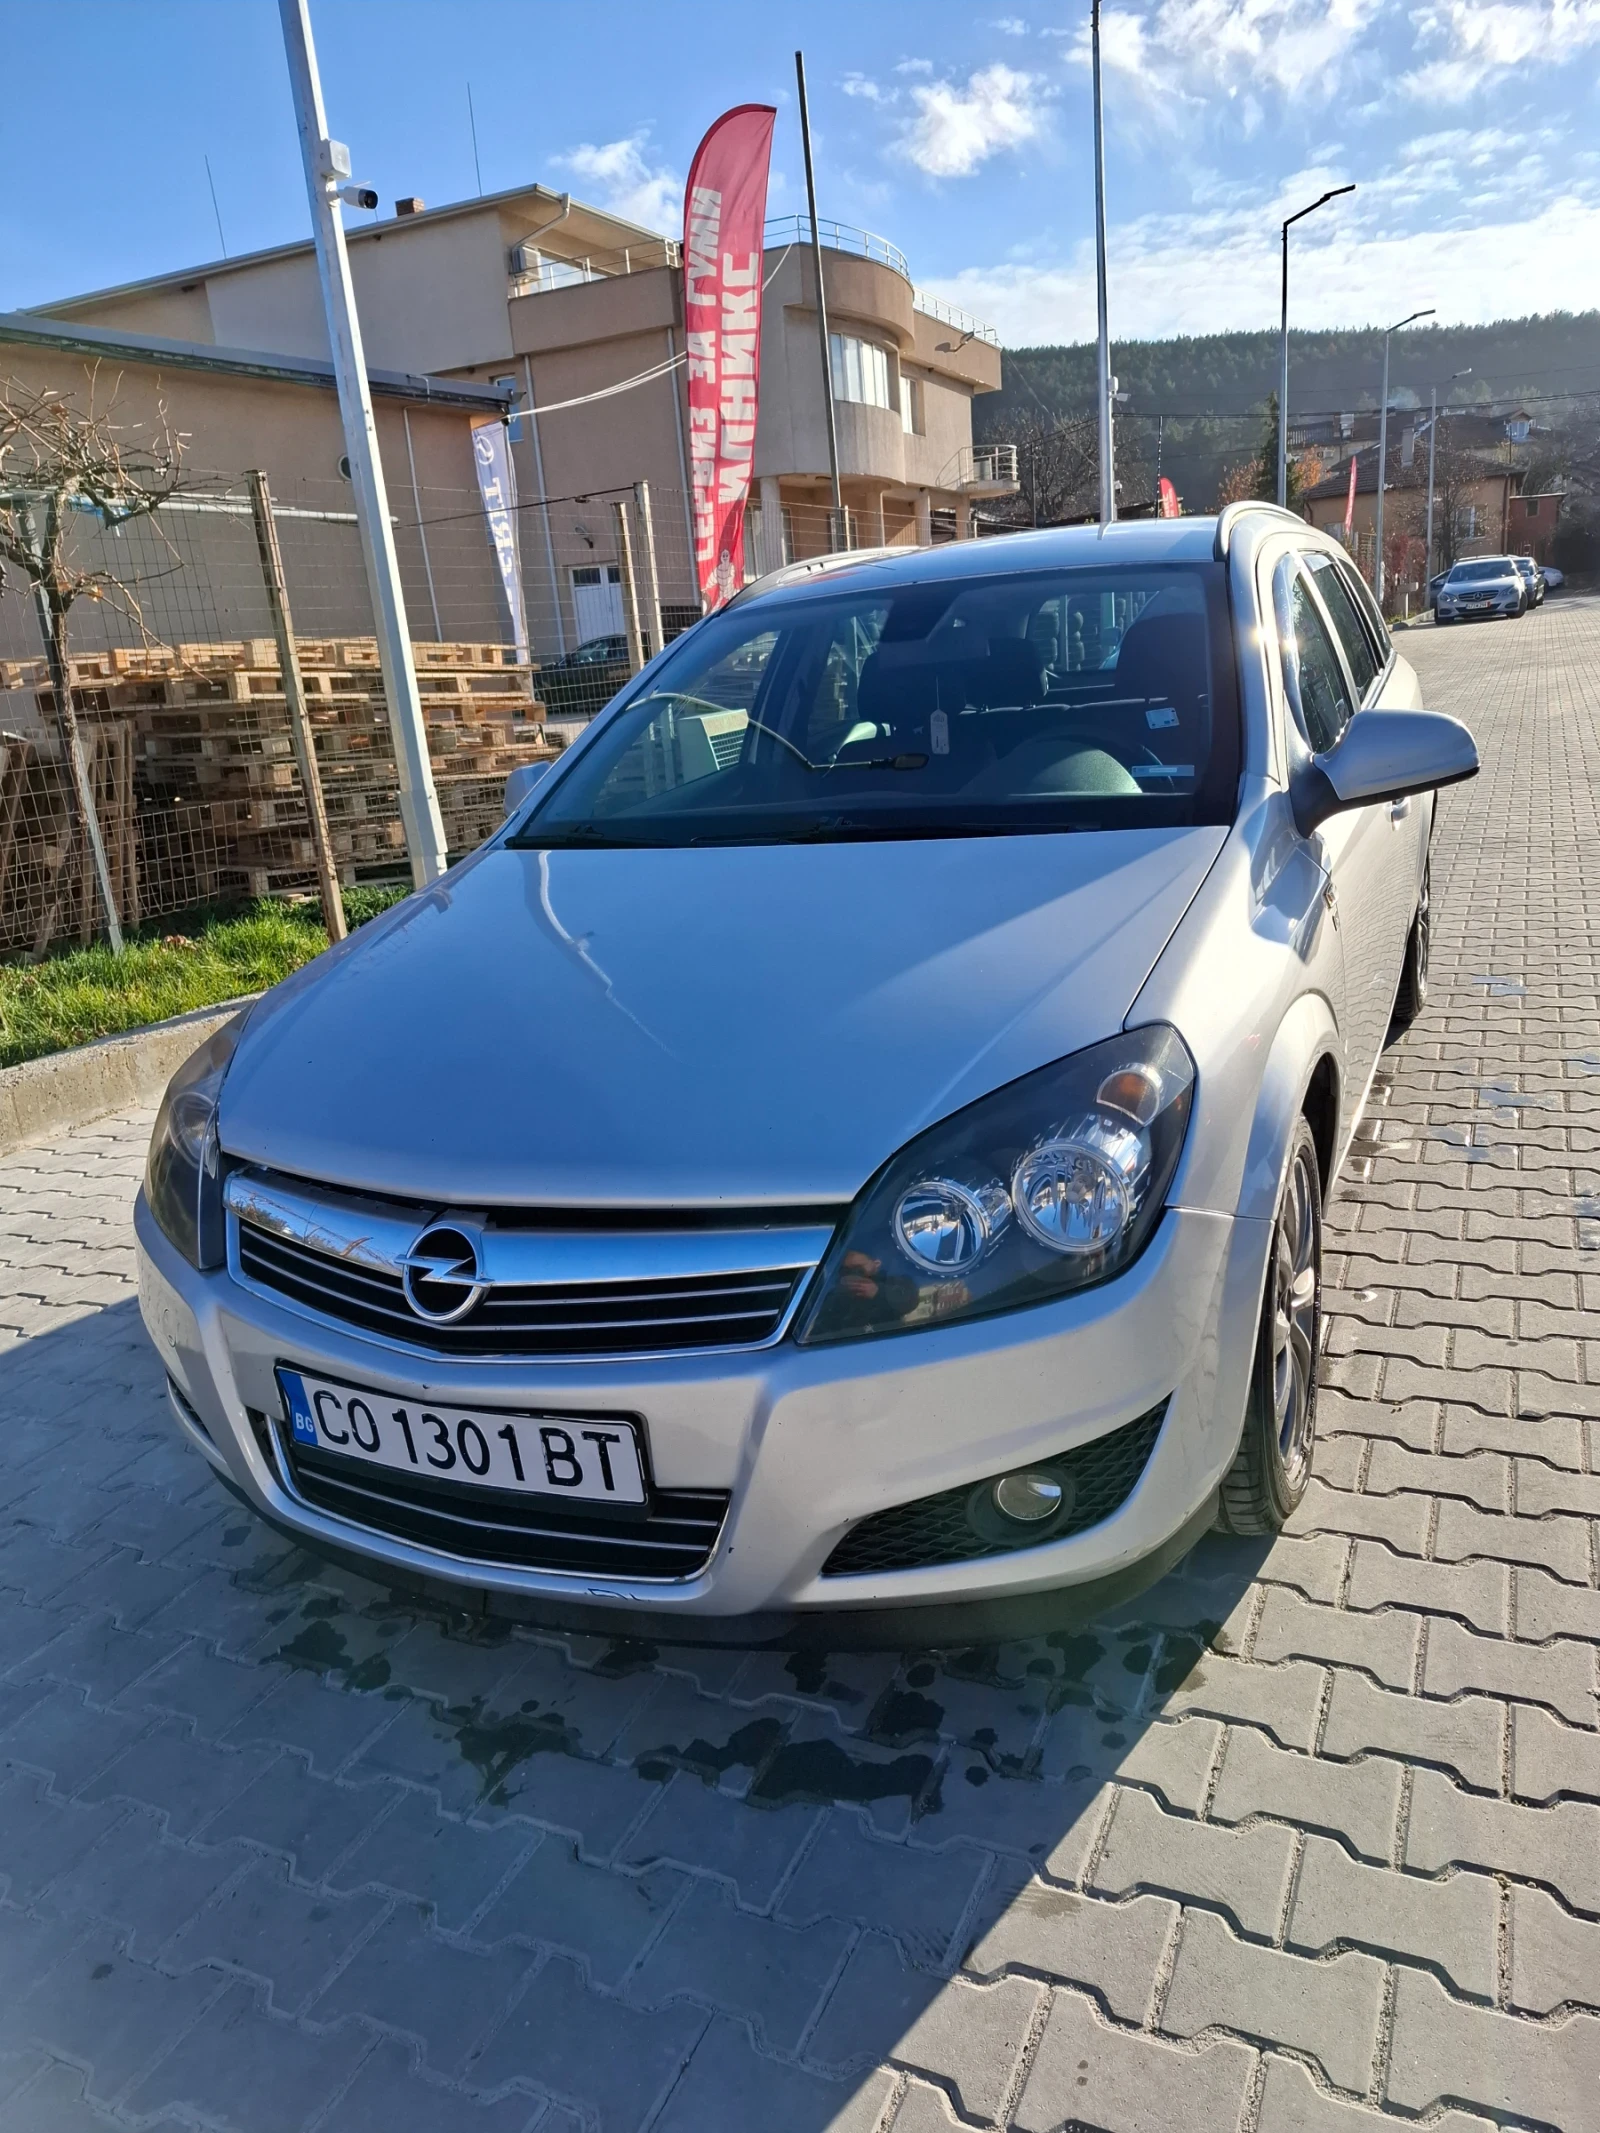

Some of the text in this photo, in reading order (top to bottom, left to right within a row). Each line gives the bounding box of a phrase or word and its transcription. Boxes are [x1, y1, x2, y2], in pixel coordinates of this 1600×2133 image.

[687, 186, 722, 562] СЕРВИЗ ЗА ГУМИ
[294, 1415, 315, 1434] BG
[392, 1407, 526, 1482] 1301
[538, 1427, 621, 1491] BT
